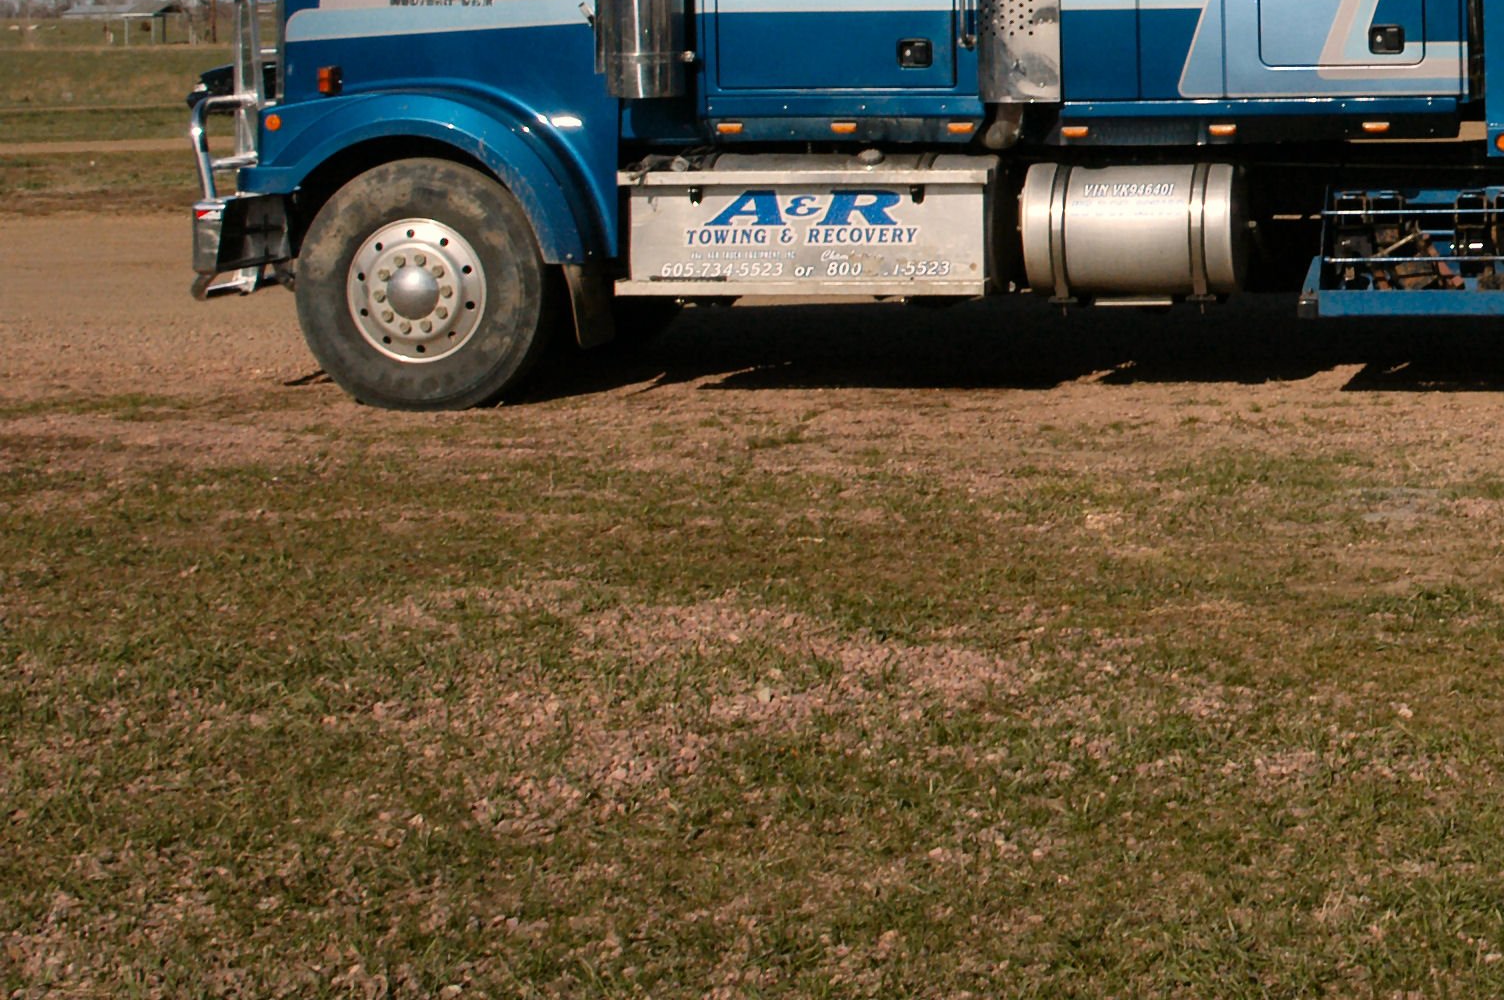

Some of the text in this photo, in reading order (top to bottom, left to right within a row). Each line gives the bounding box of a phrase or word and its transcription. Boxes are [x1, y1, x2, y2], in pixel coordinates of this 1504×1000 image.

[1083, 184, 1109, 197] VIN
[704, 189, 903, 226] A&R
[686, 227, 918, 245] TOWING & RECOVERY
[661, 262, 783, 278] 605-734-5523
[794, 264, 814, 278] or
